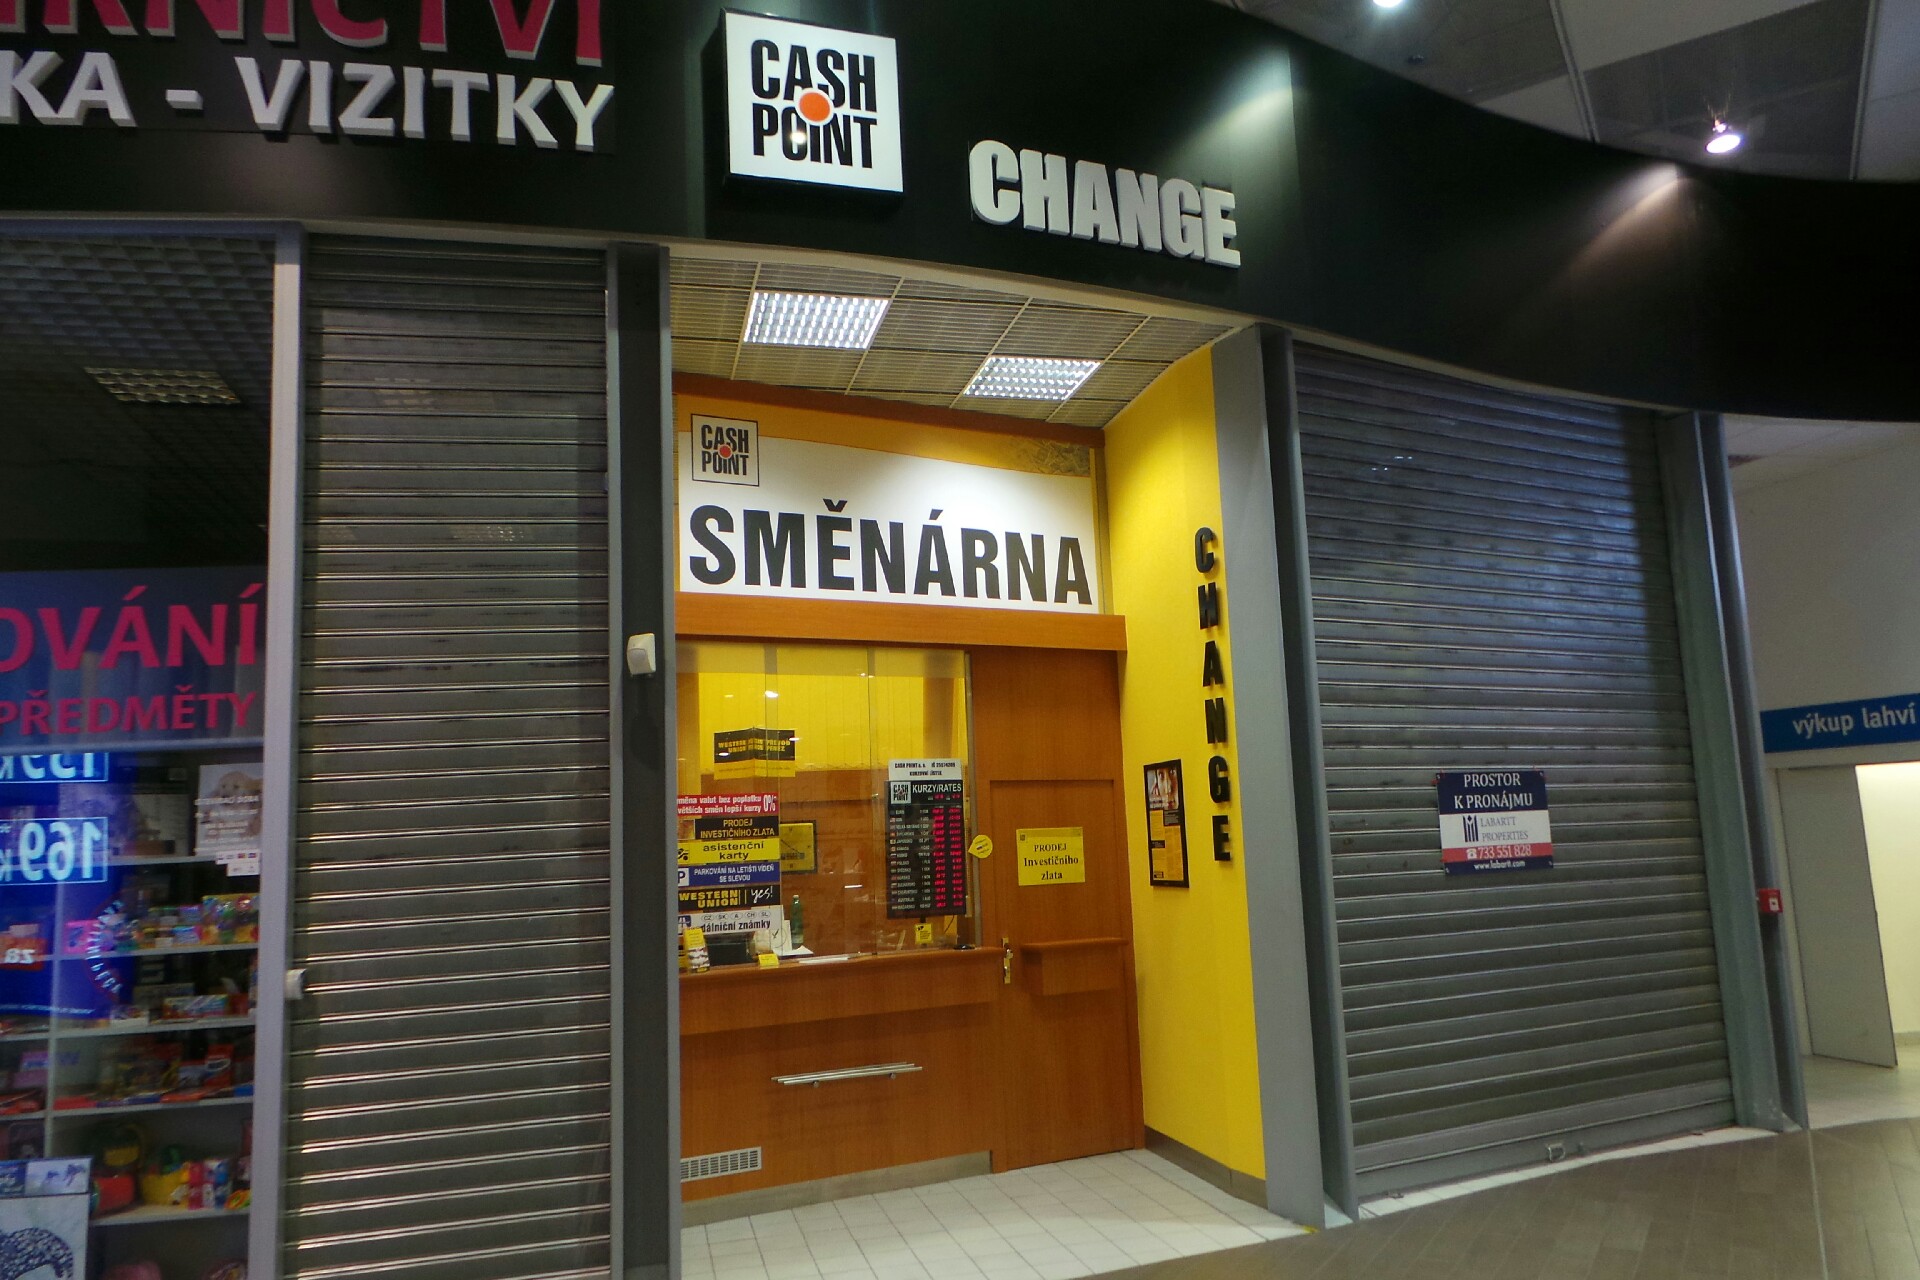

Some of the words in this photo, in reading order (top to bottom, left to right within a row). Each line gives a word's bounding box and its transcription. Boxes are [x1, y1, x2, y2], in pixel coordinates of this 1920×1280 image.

[751, 39, 877, 113] CASH
[235, 56, 614, 152] VIZITKY
[752, 102, 877, 169] POINT
[969, 139, 1241, 269] CHANGE
[701, 424, 749, 453] CASH
[702, 450, 749, 476] POINT
[689, 498, 1092, 606] SMĚNÁRNA
[1194, 527, 1231, 862] CHANGE
[0, 685, 256, 735] PŘEDMĚTY
[1793, 712, 1854, 739] výkup
[1862, 702, 1916, 729] lahví
[1463, 772, 1521, 788] PROSTOR
[912, 783, 962, 793] KURZY/RATES
[699, 796, 716, 804] valut
[718, 795, 730, 803] bez
[732, 795, 761, 804] poplatku
[1454, 795, 1464, 809] K
[1466, 790, 1533, 810] PRONÁJMU
[705, 805, 723, 813] směn
[724, 805, 742, 814] lepší
[744, 804, 761, 813] kurzy
[723, 818, 753, 827] PRODEJ
[700, 828, 751, 839] INVESTIČNÍHO
[752, 828, 775, 836] ZLATA
[1481, 831, 1529, 842] PROPERTIES
[703, 841, 764, 852] asistenční
[1034, 843, 1067, 852] PRODEJ
[1477, 846, 1495, 859] 733
[1497, 845, 1512, 858] 551
[1514, 844, 1532, 856] 828
[719, 852, 749, 860] karty
[1024, 855, 1079, 866] Investičního
[694, 865, 727, 875] PARKOVÁNÍ
[1041, 870, 1063, 880] zlata
[728, 874, 751, 882] SLEVOU
[679, 889, 738, 901] WESTERN
[751, 885, 773, 904] yes!
[697, 897, 738, 908] UNION
[738, 919, 771, 930] známky
